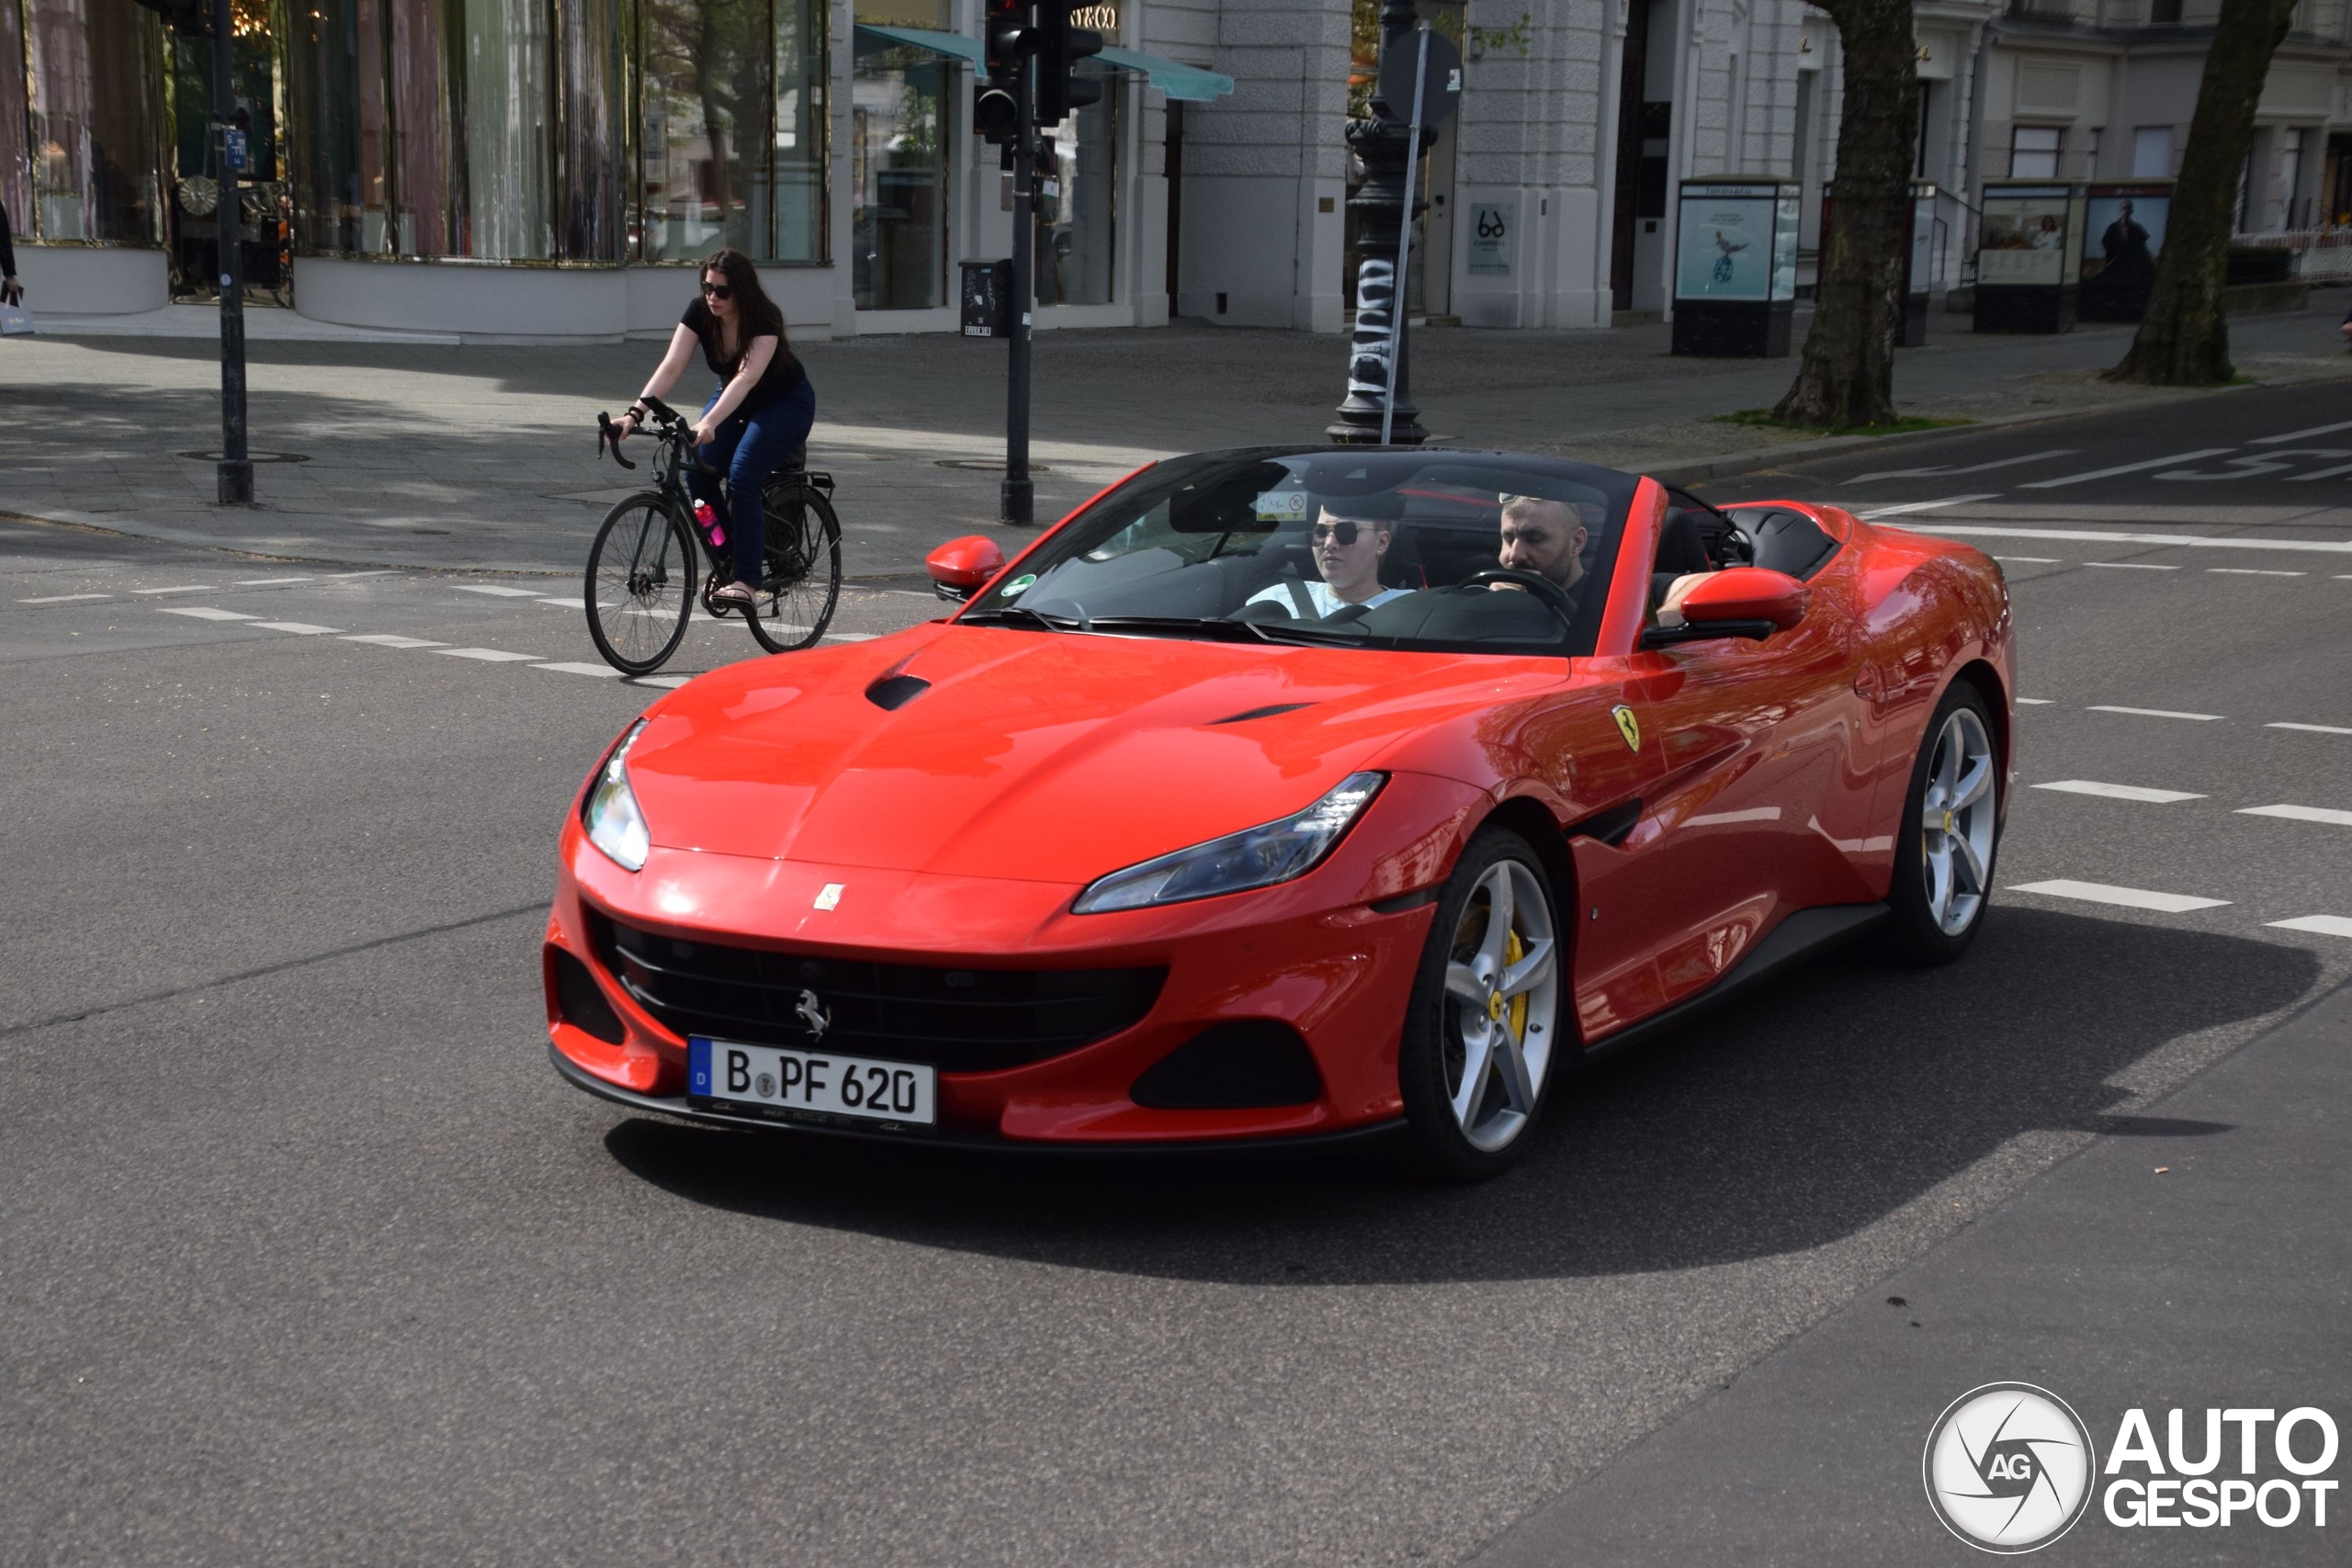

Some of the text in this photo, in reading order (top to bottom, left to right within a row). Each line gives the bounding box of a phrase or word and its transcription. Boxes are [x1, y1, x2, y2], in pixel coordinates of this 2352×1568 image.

[696, 1073, 706, 1086] D
[728, 1050, 917, 1113] B PF 620
